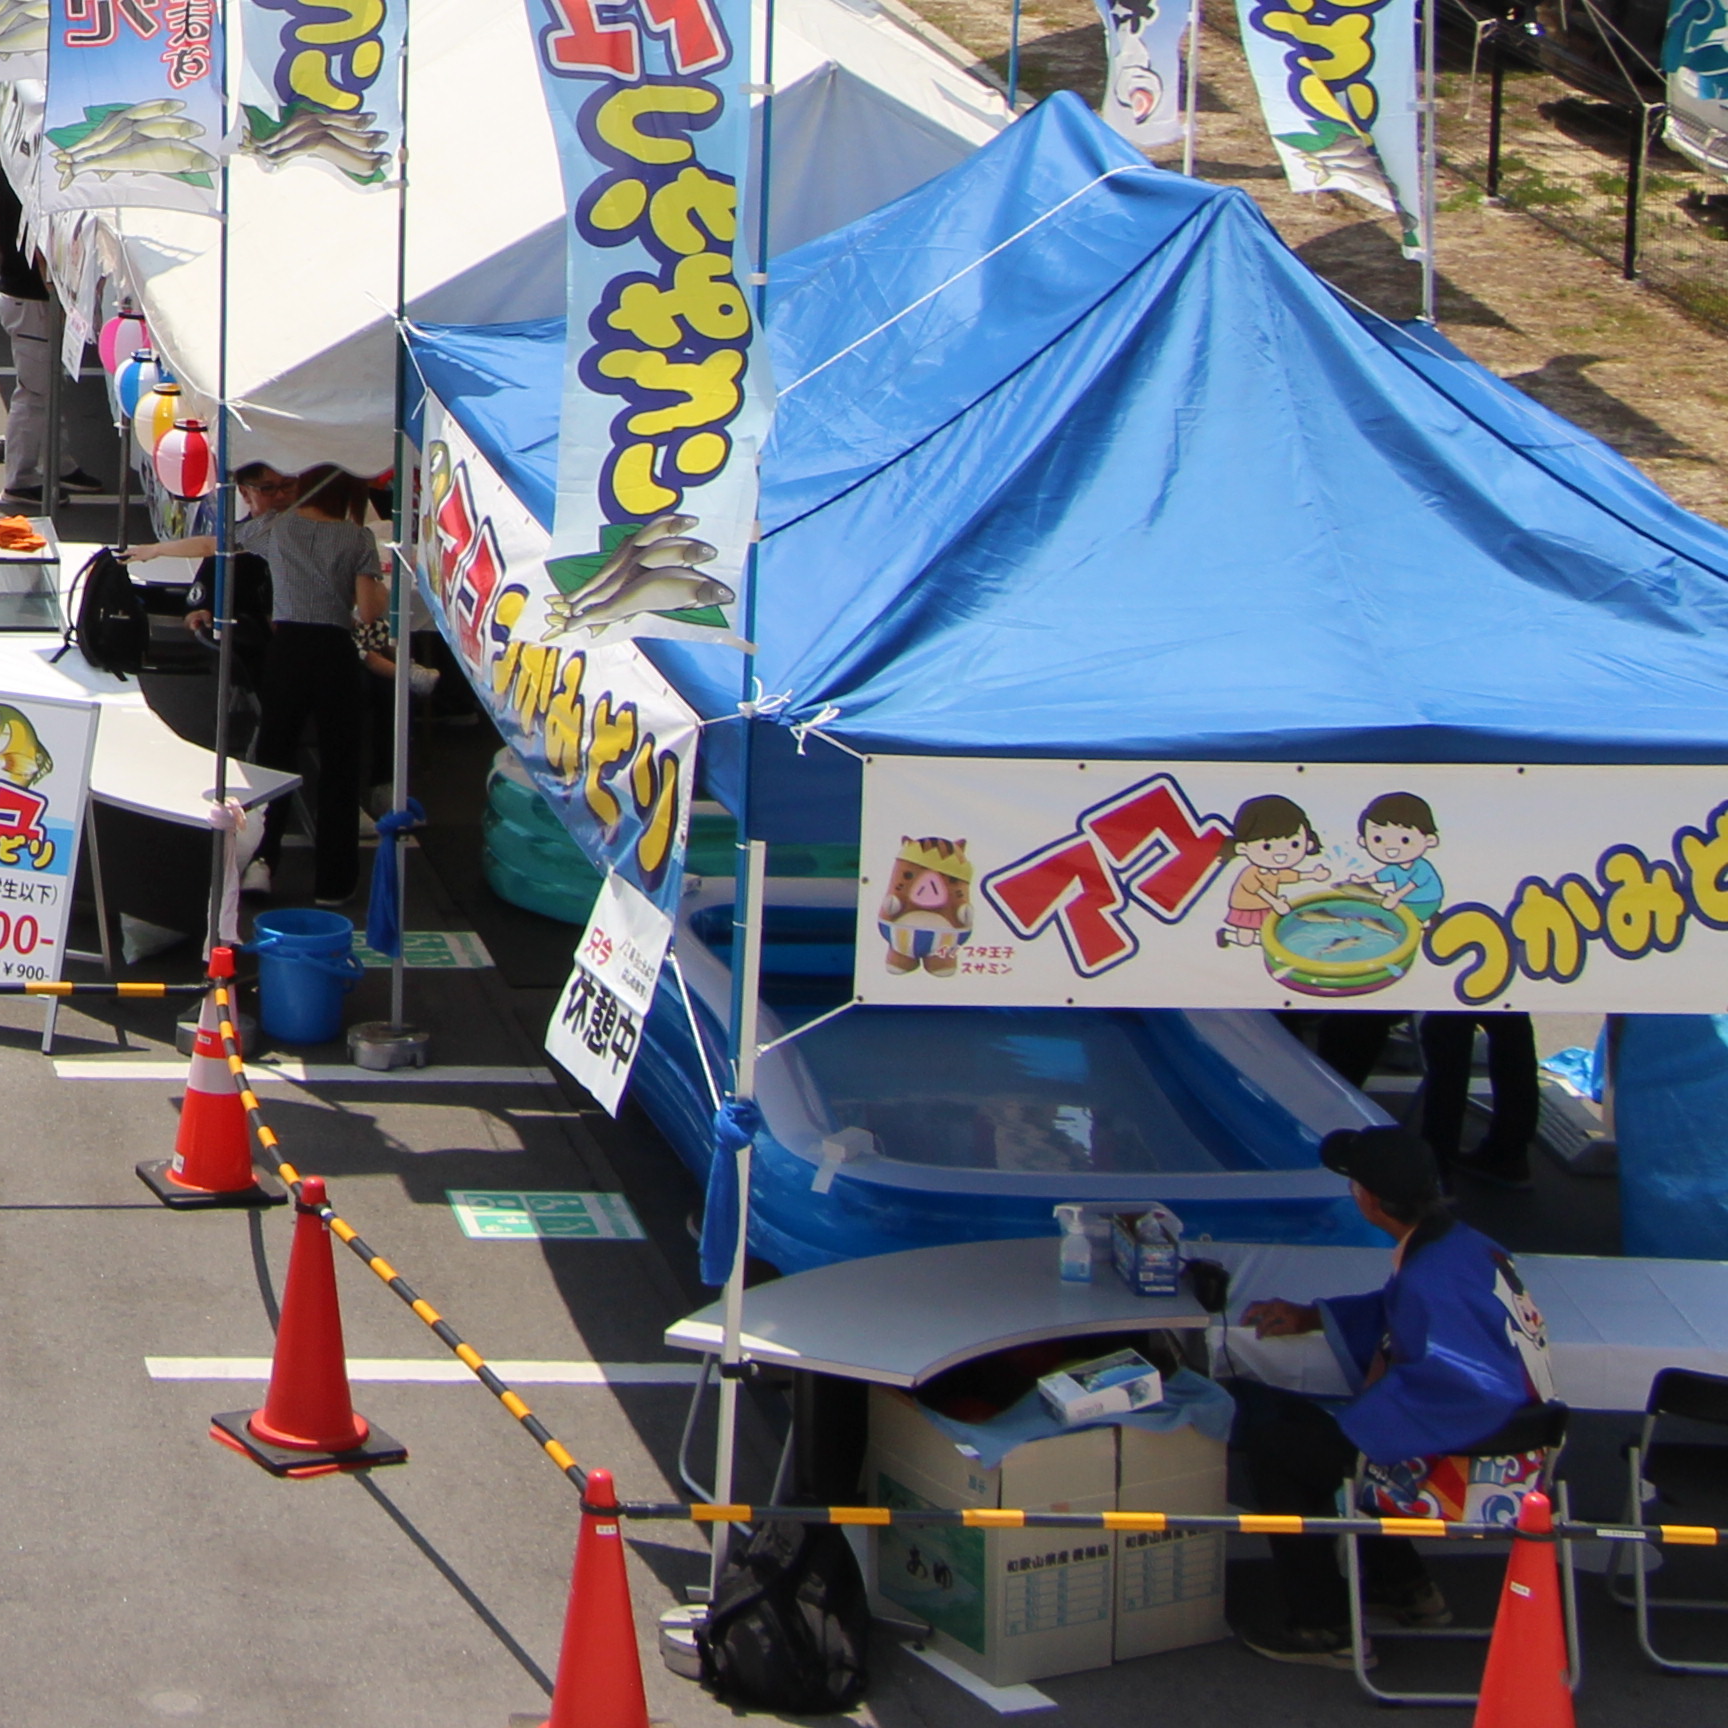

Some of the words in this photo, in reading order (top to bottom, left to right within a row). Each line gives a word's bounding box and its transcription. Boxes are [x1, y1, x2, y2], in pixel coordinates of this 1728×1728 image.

[981, 771, 1235, 980] アユ
[584, 927, 614, 966] 只今
[561, 968, 637, 1075] 休憩中
